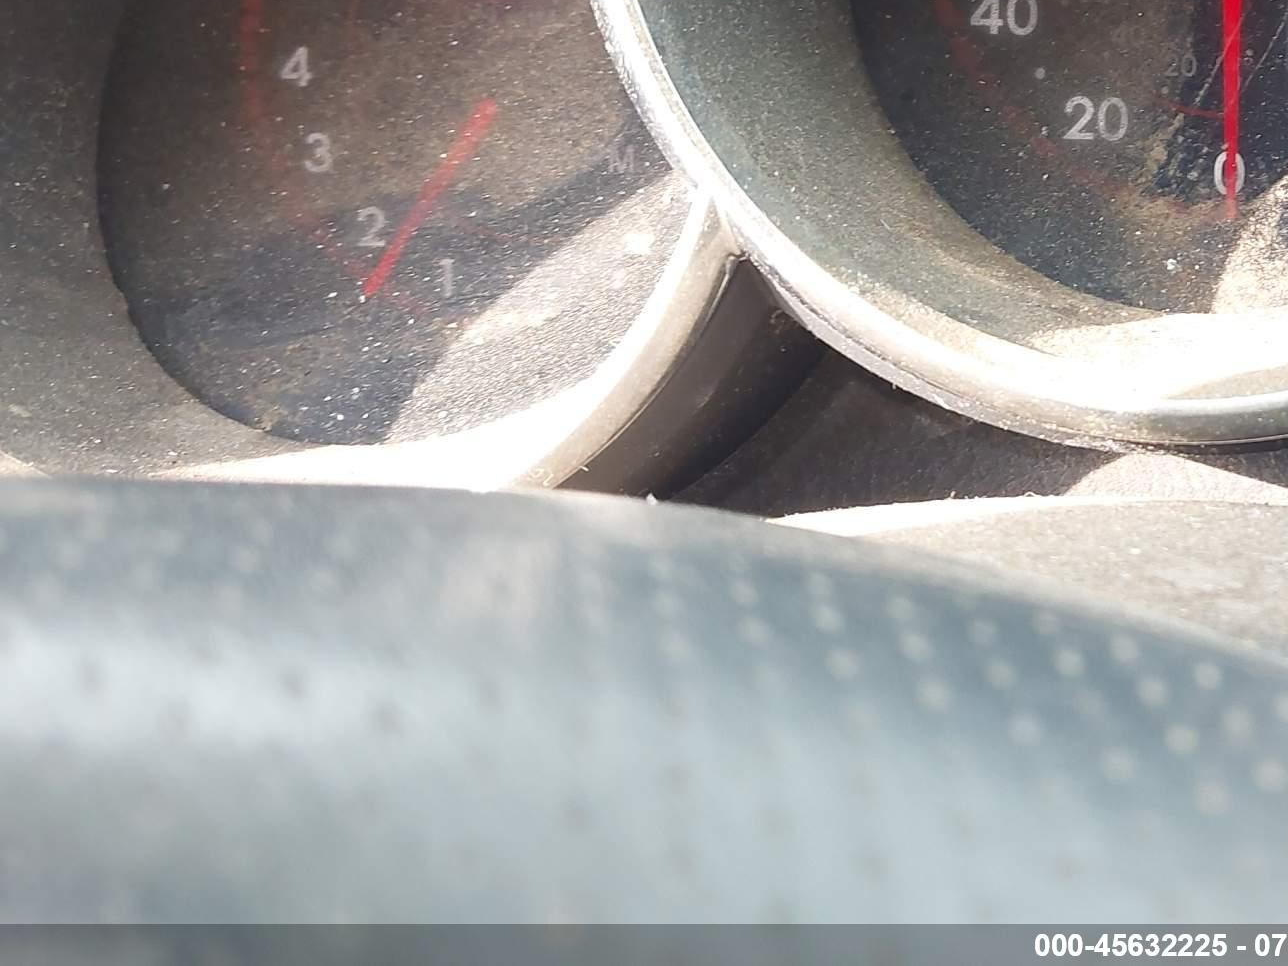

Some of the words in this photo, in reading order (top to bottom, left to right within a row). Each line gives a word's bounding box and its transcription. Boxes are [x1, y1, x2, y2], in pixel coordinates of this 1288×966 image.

[279, 47, 313, 86] 4
[1165, 54, 1197, 77] 20
[1063, 96, 1129, 141] 20
[304, 133, 332, 172] 3
[1213, 151, 1245, 195] 0
[356, 206, 386, 248] 2
[439, 259, 454, 298] 1
